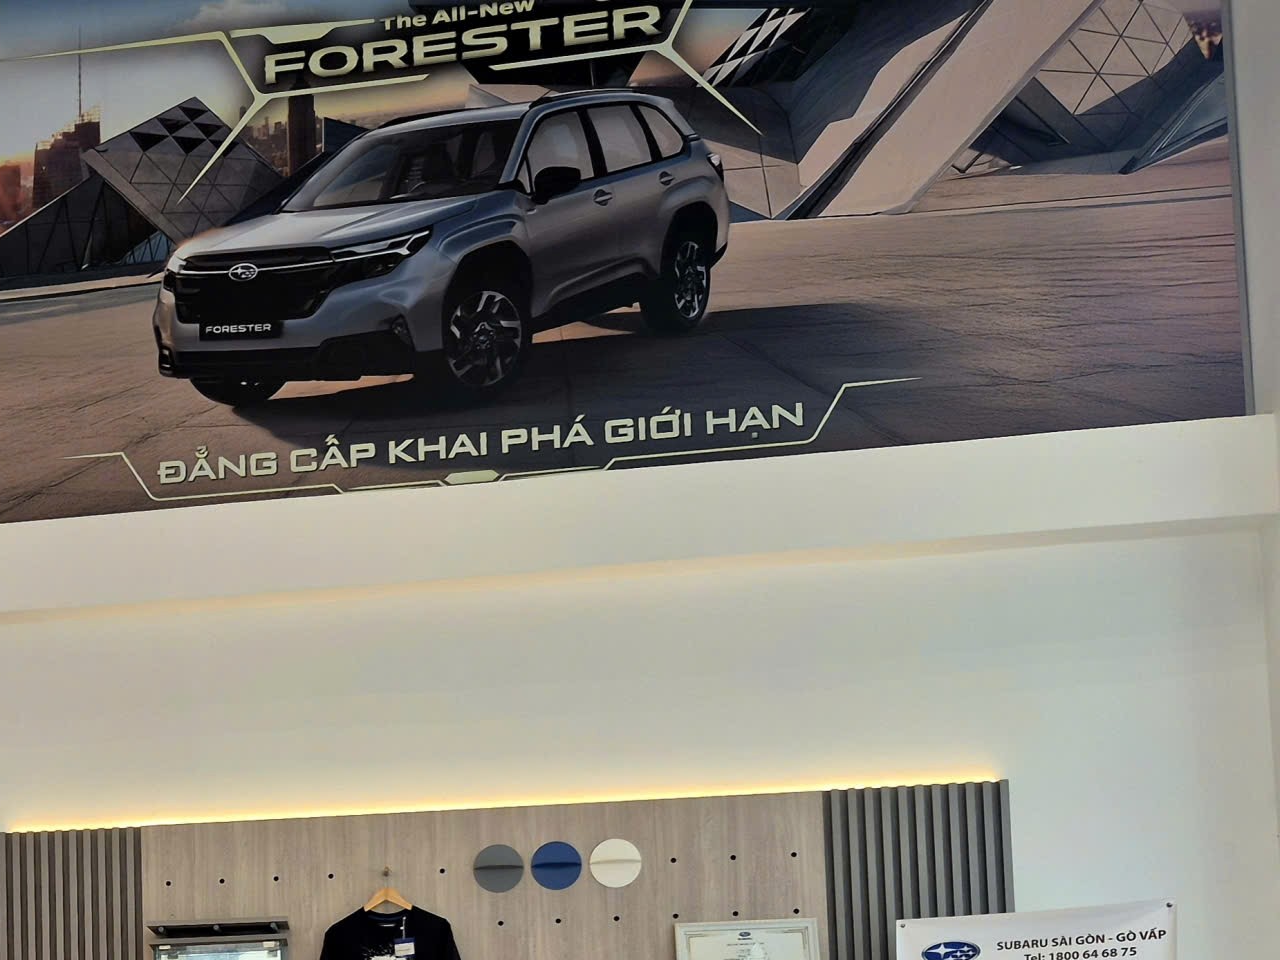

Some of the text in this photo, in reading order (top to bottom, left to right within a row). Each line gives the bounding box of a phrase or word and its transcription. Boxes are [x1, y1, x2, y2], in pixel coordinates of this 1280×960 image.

[379, 0, 535, 31] The All-New
[264, 5, 662, 85] FORESTER
[205, 323, 272, 334] FORESTER
[157, 402, 803, 484] ĐẲNG CẤP KHAI PHÁ GIỚI HẠN
[997, 938, 1048, 950] SUBARU
[1051, 934, 1072, 947] SÀI
[1075, 930, 1106, 945] GÒN
[1116, 929, 1137, 942] GÒ
[1139, 928, 1167, 941] VẤP
[1082, 949, 1098, 959] 64
[1101, 948, 1118, 958] 68
[1120, 946, 1137, 957] 75
